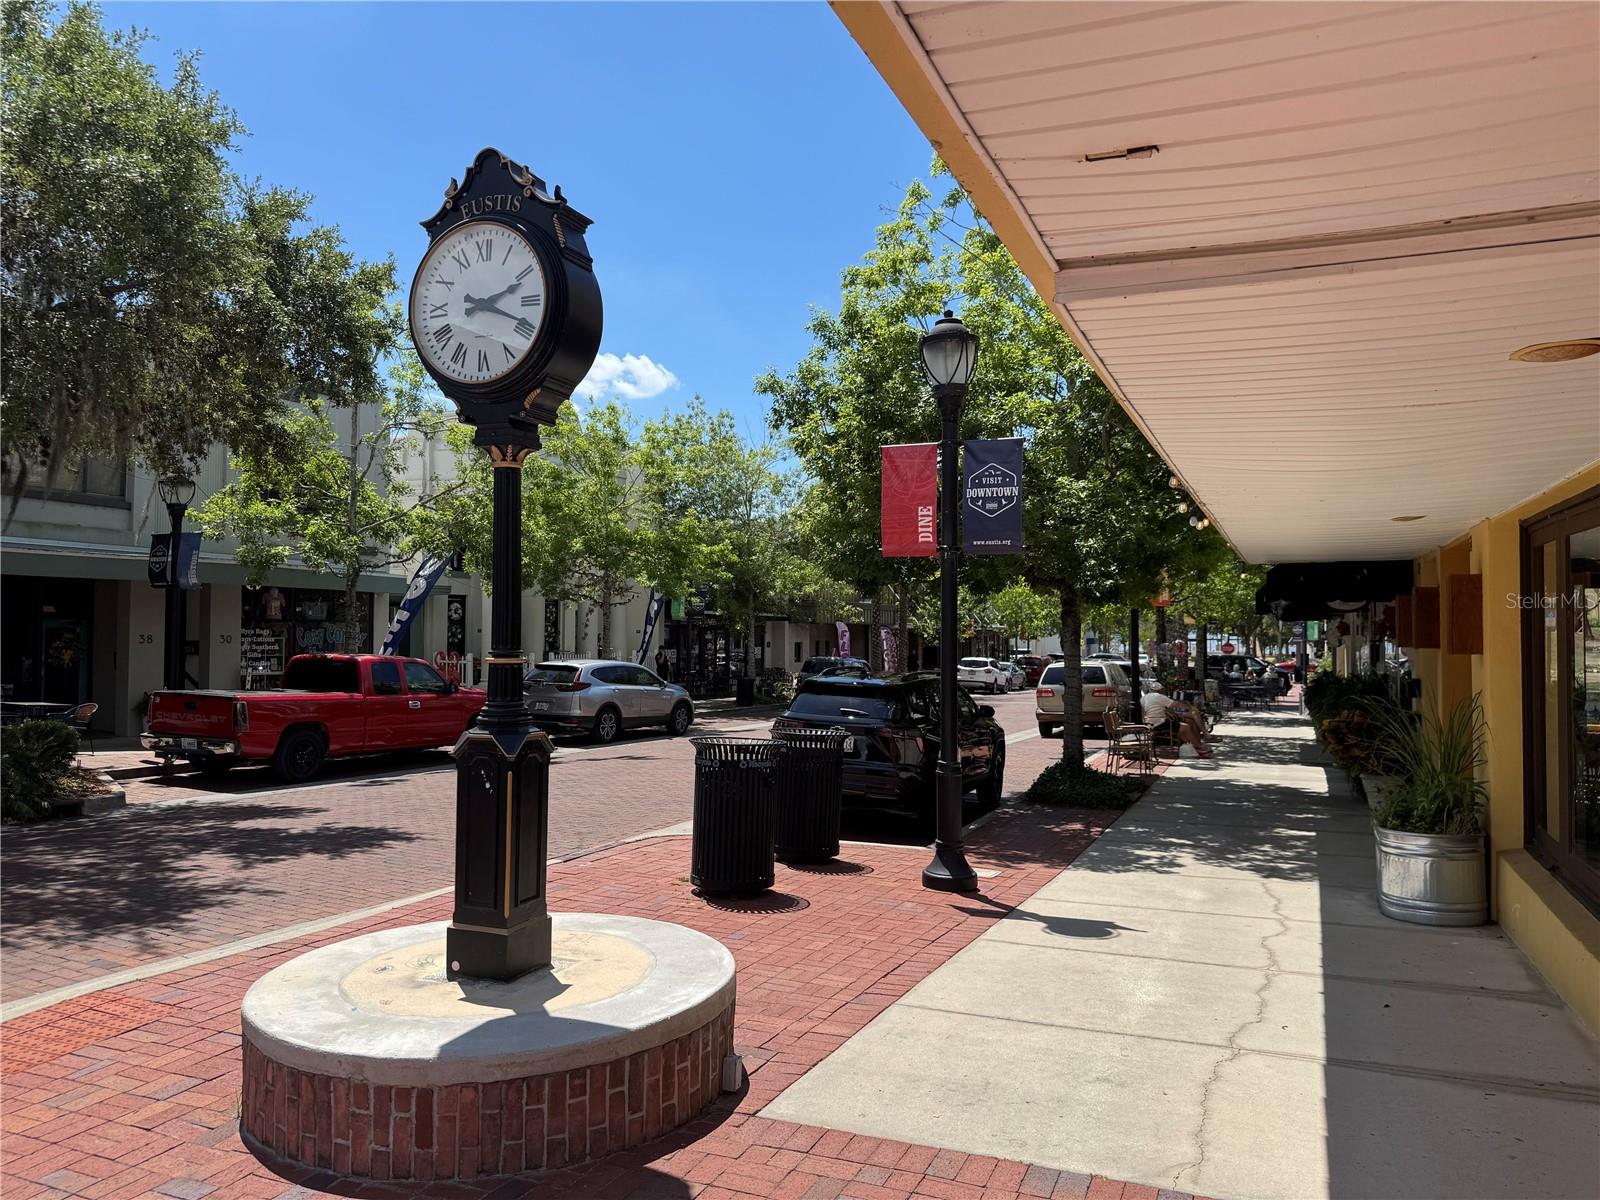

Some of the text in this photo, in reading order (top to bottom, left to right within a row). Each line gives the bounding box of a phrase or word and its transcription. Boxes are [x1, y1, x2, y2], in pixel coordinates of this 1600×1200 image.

[461, 194, 522, 220] EUSTIS
[476, 238, 492, 263] XII
[452, 248, 471, 274] XI
[435, 273, 455, 292] X
[430, 302, 448, 319] IX
[502, 343, 516, 364] V
[982, 476, 1003, 485] VISIT
[966, 486, 1019, 498] DOWNTOWN
[918, 505, 933, 543] DINE
[138, 634, 153, 644] 38
[219, 634, 232, 644] 30
[255, 628, 270, 636] Bags
[155, 711, 228, 724] CHEVROLET
